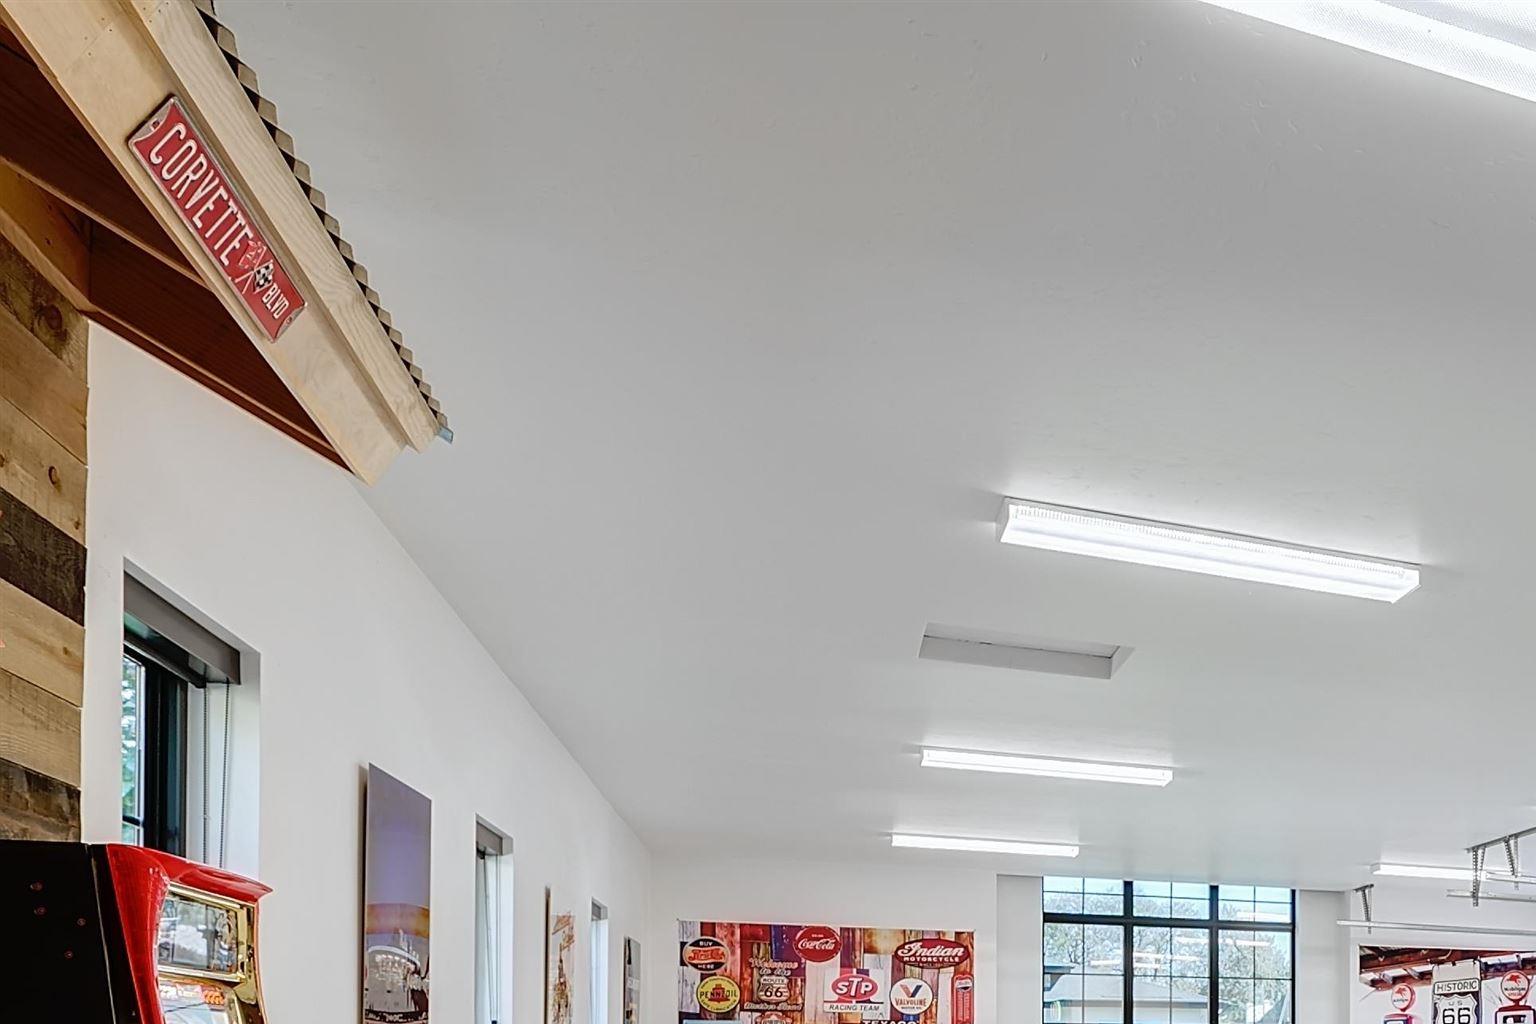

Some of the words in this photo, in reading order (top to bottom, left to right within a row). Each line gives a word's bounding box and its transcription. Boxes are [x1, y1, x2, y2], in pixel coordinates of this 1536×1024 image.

[150, 122, 253, 267] CORVETTE
[262, 285, 289, 319] BLVD
[897, 942, 964, 956] Indian
[764, 986, 784, 998] 66
[835, 977, 873, 997] STP
[1436, 980, 1477, 993] HISTORIC
[700, 989, 738, 998] PENNZOIL
[829, 1003, 857, 1011] RACING
[895, 998, 927, 1006] VALVOLINE
